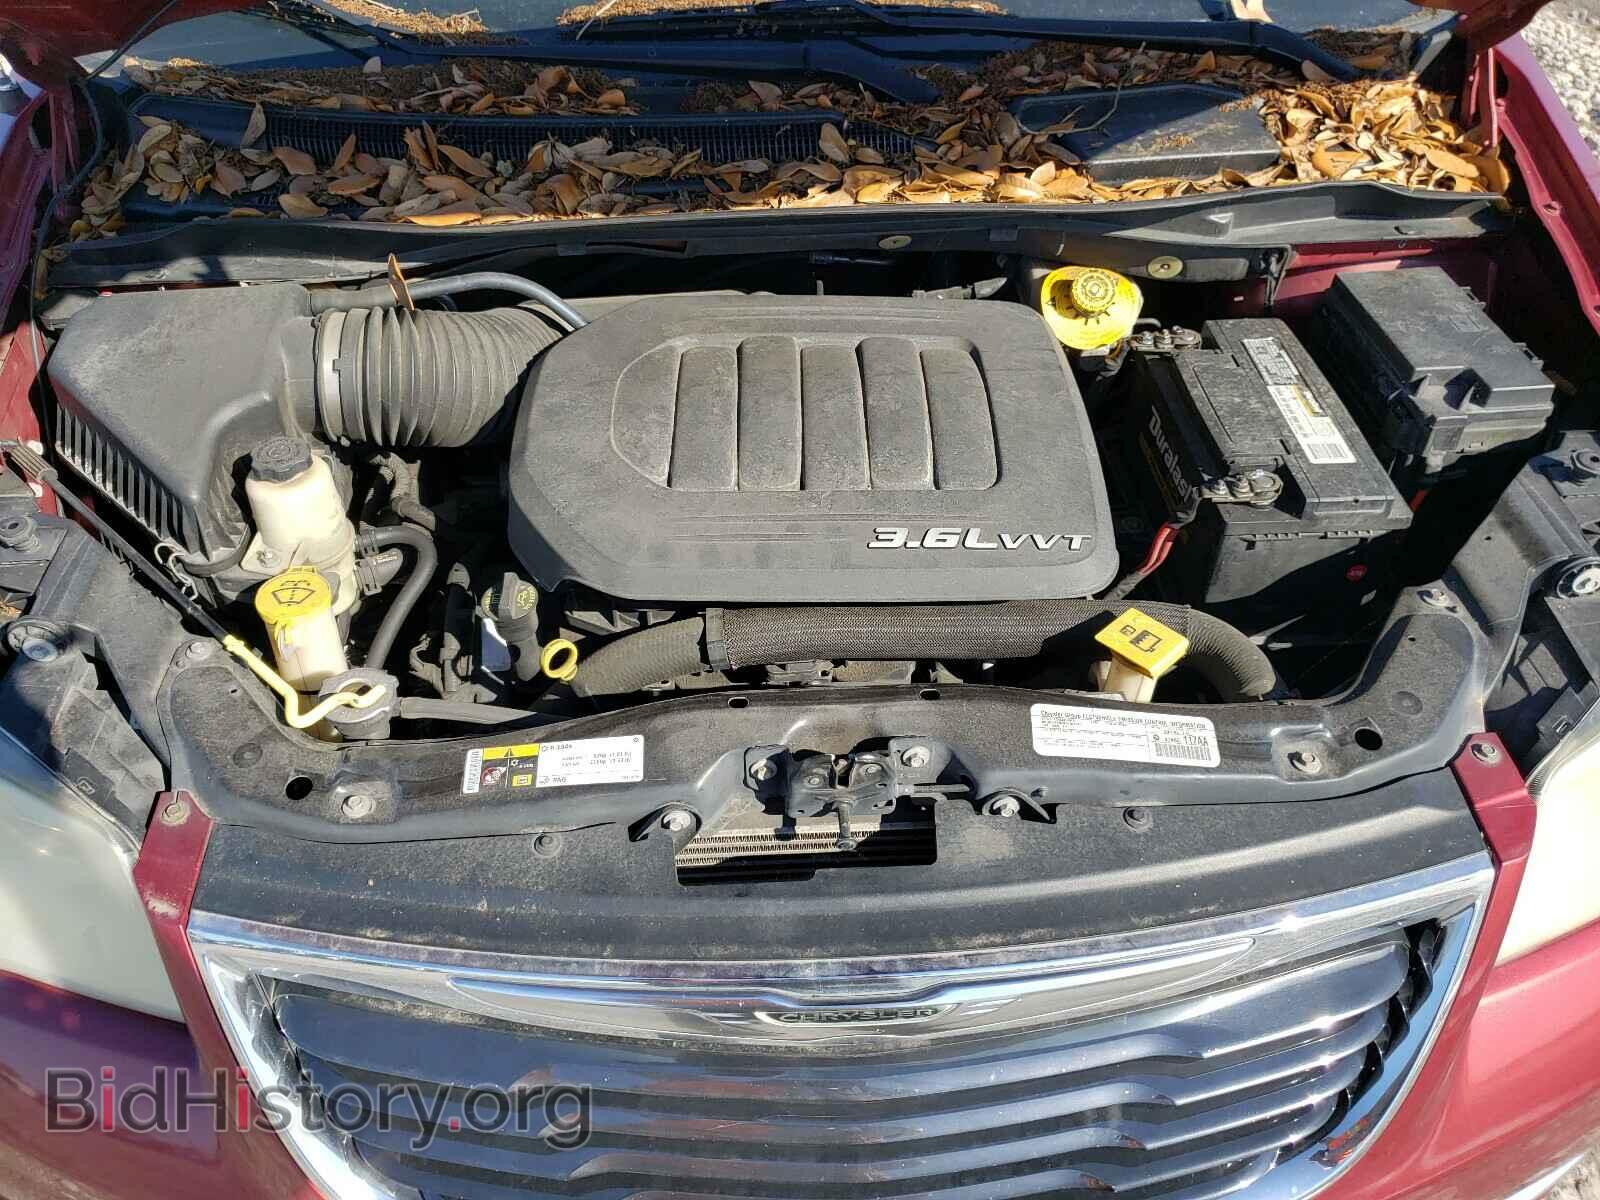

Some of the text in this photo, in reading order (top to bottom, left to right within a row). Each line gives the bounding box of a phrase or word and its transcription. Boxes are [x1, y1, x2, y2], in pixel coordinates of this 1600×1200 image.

[867, 527, 1092, 551] 3.6L VVT
[778, 1008, 933, 1023] CHRYSLER
